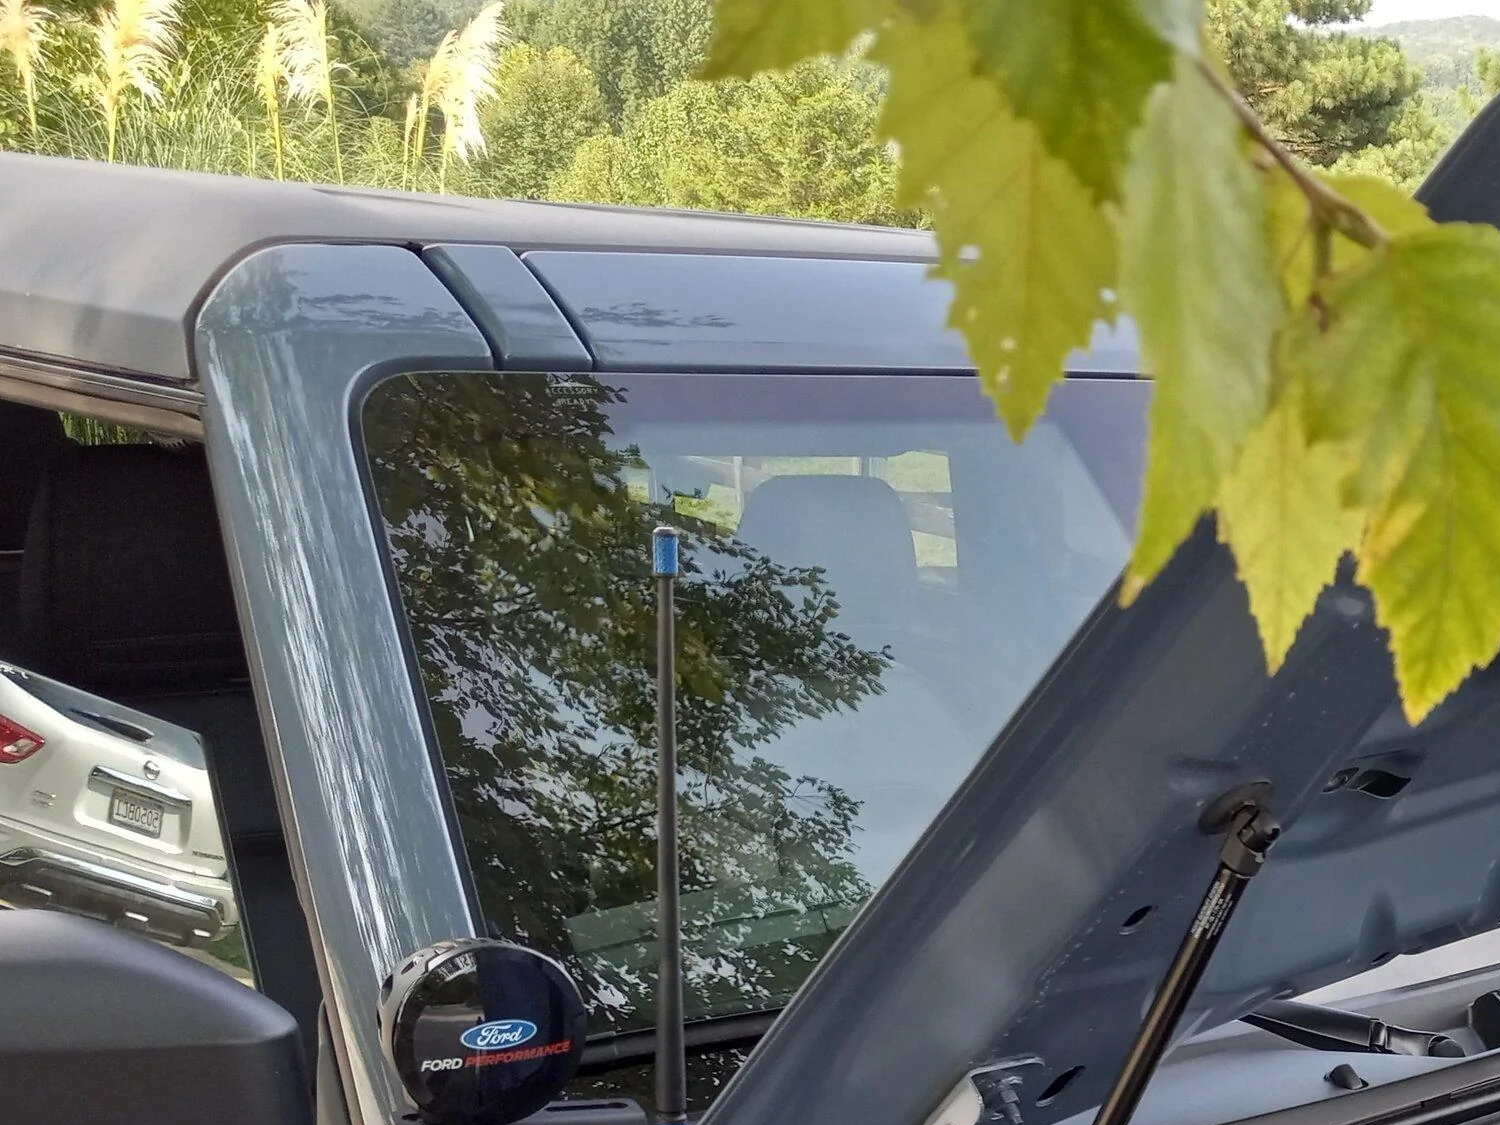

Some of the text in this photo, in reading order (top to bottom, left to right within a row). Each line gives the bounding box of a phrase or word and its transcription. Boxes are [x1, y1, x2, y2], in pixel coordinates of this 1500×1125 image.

[477, 1024, 522, 1046] Ford
[421, 1041, 572, 1072] FORD PERFORMANCE
